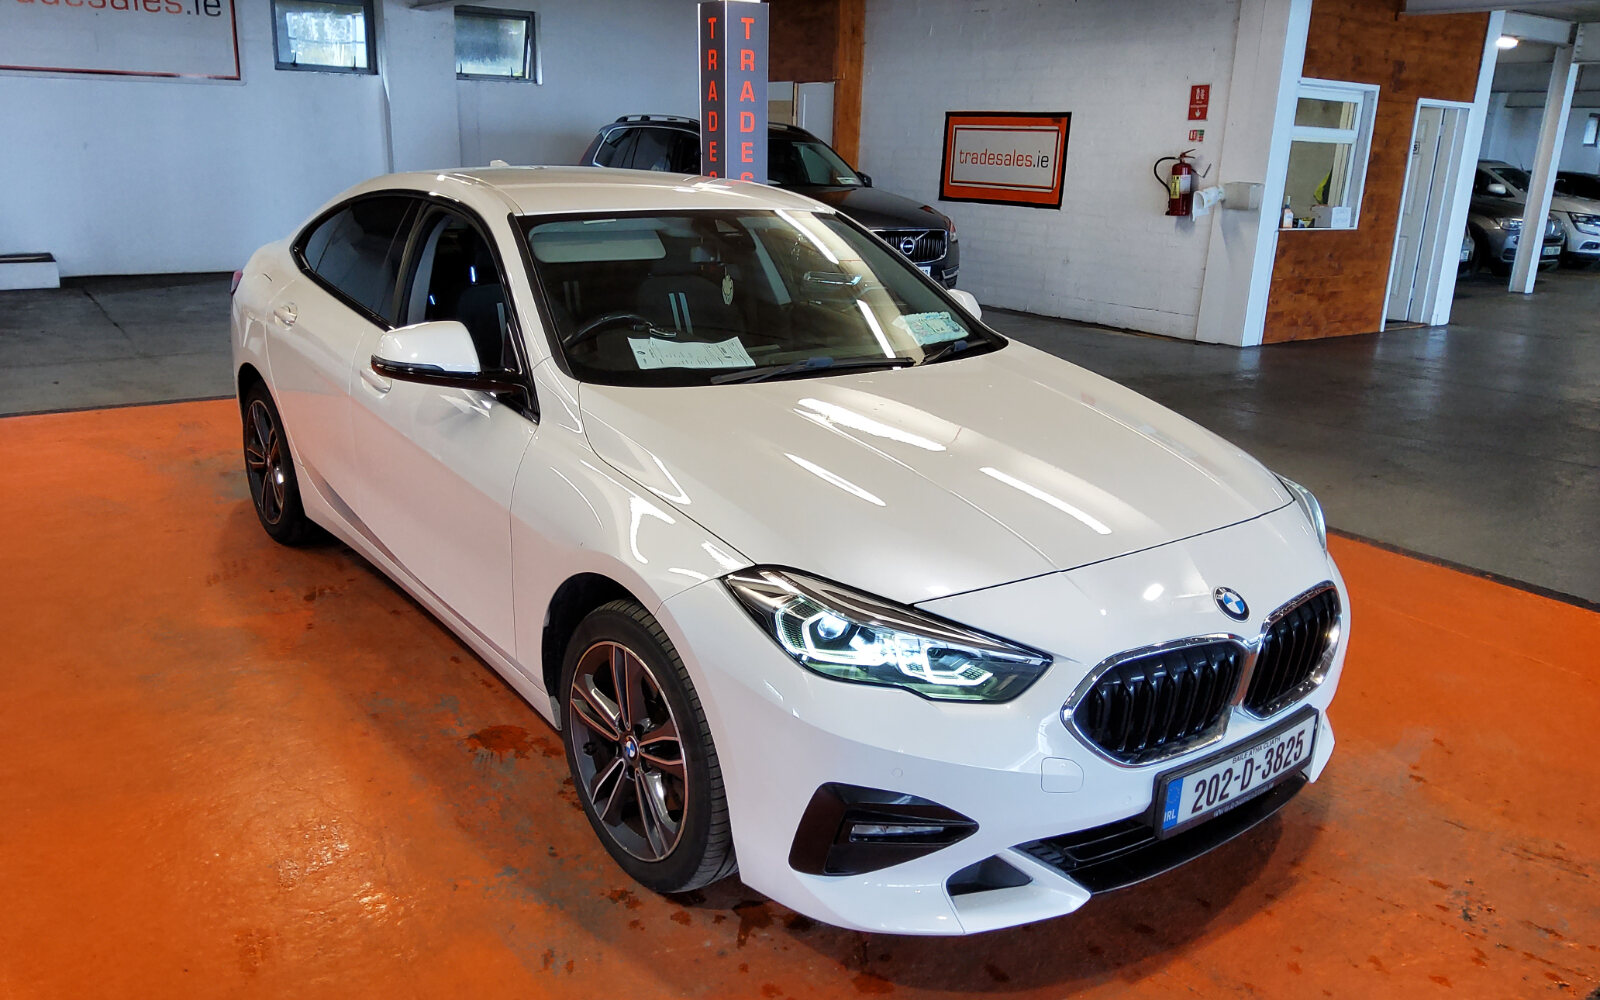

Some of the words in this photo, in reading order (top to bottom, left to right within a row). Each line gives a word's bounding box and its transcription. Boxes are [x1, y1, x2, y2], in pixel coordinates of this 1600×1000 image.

[959, 148, 1050, 168] tradesales.ie
[1191, 730, 1305, 814] 202-D-3825
[1163, 809, 1177, 823] IRL
